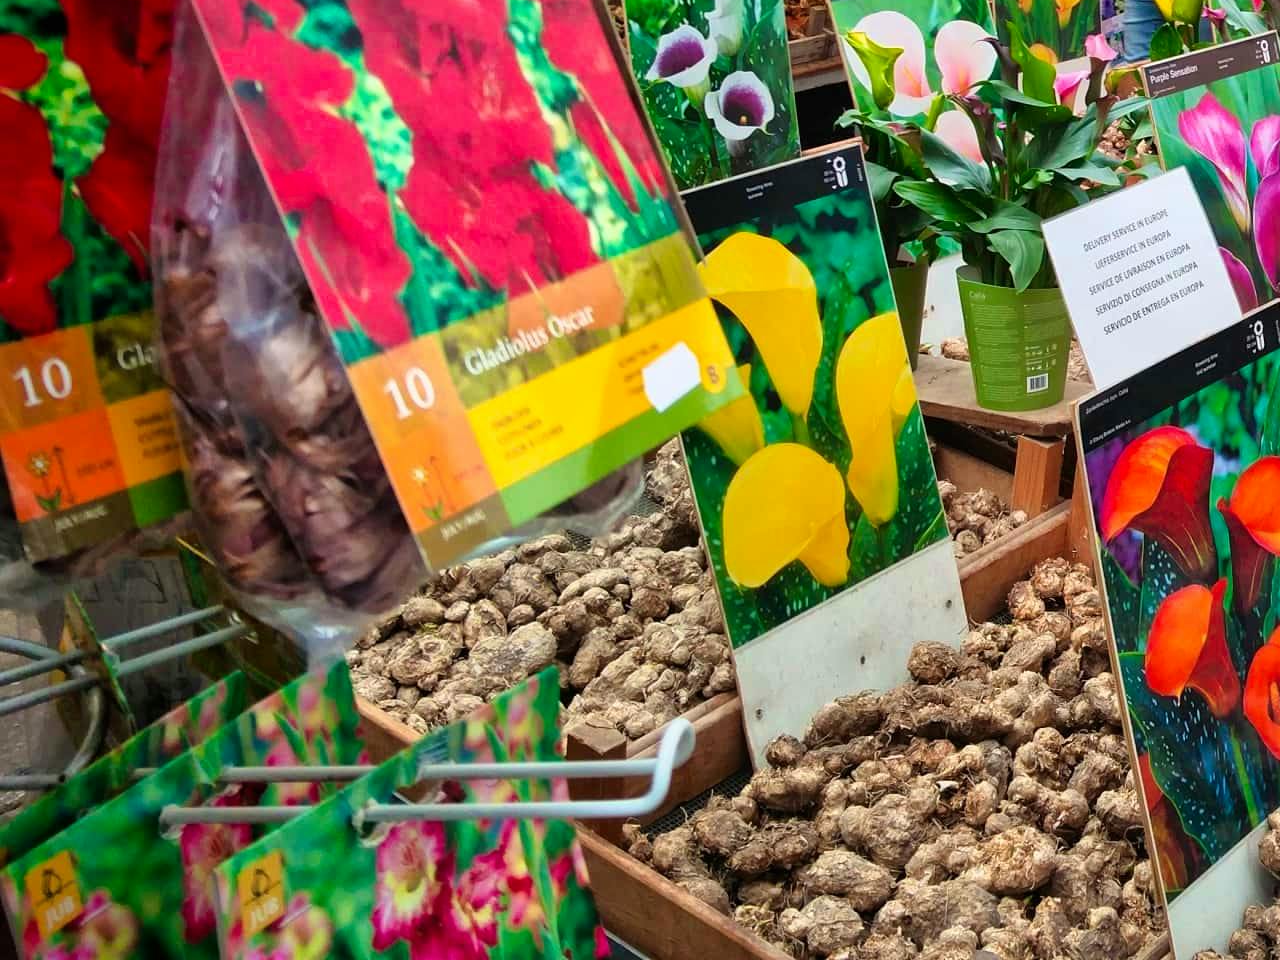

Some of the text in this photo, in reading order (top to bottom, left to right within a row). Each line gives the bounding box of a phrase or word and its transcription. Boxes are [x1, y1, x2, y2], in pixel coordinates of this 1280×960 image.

[1150, 64, 1199, 85] Purple Sensation
[1083, 208, 1170, 253] DELIVERY SERVICE IN EUROPE
[1094, 229, 1172, 270] LIEFERSERVICE IN EUROPA
[1088, 242, 1192, 296] SERVICE DE LIVRAISON EN EUROPA
[1095, 260, 1199, 316] SERVIZIO DI CONSEGNA IN EUROPA
[1103, 280, 1205, 336] SERVICIO DE ENTREGA EN EUROPA
[463, 304, 596, 376] Gladiolus Oscar
[12, 356, 74, 408] 10
[383, 365, 436, 421] 10
[45, 895, 75, 930] JUB
[250, 896, 281, 930] JUB
